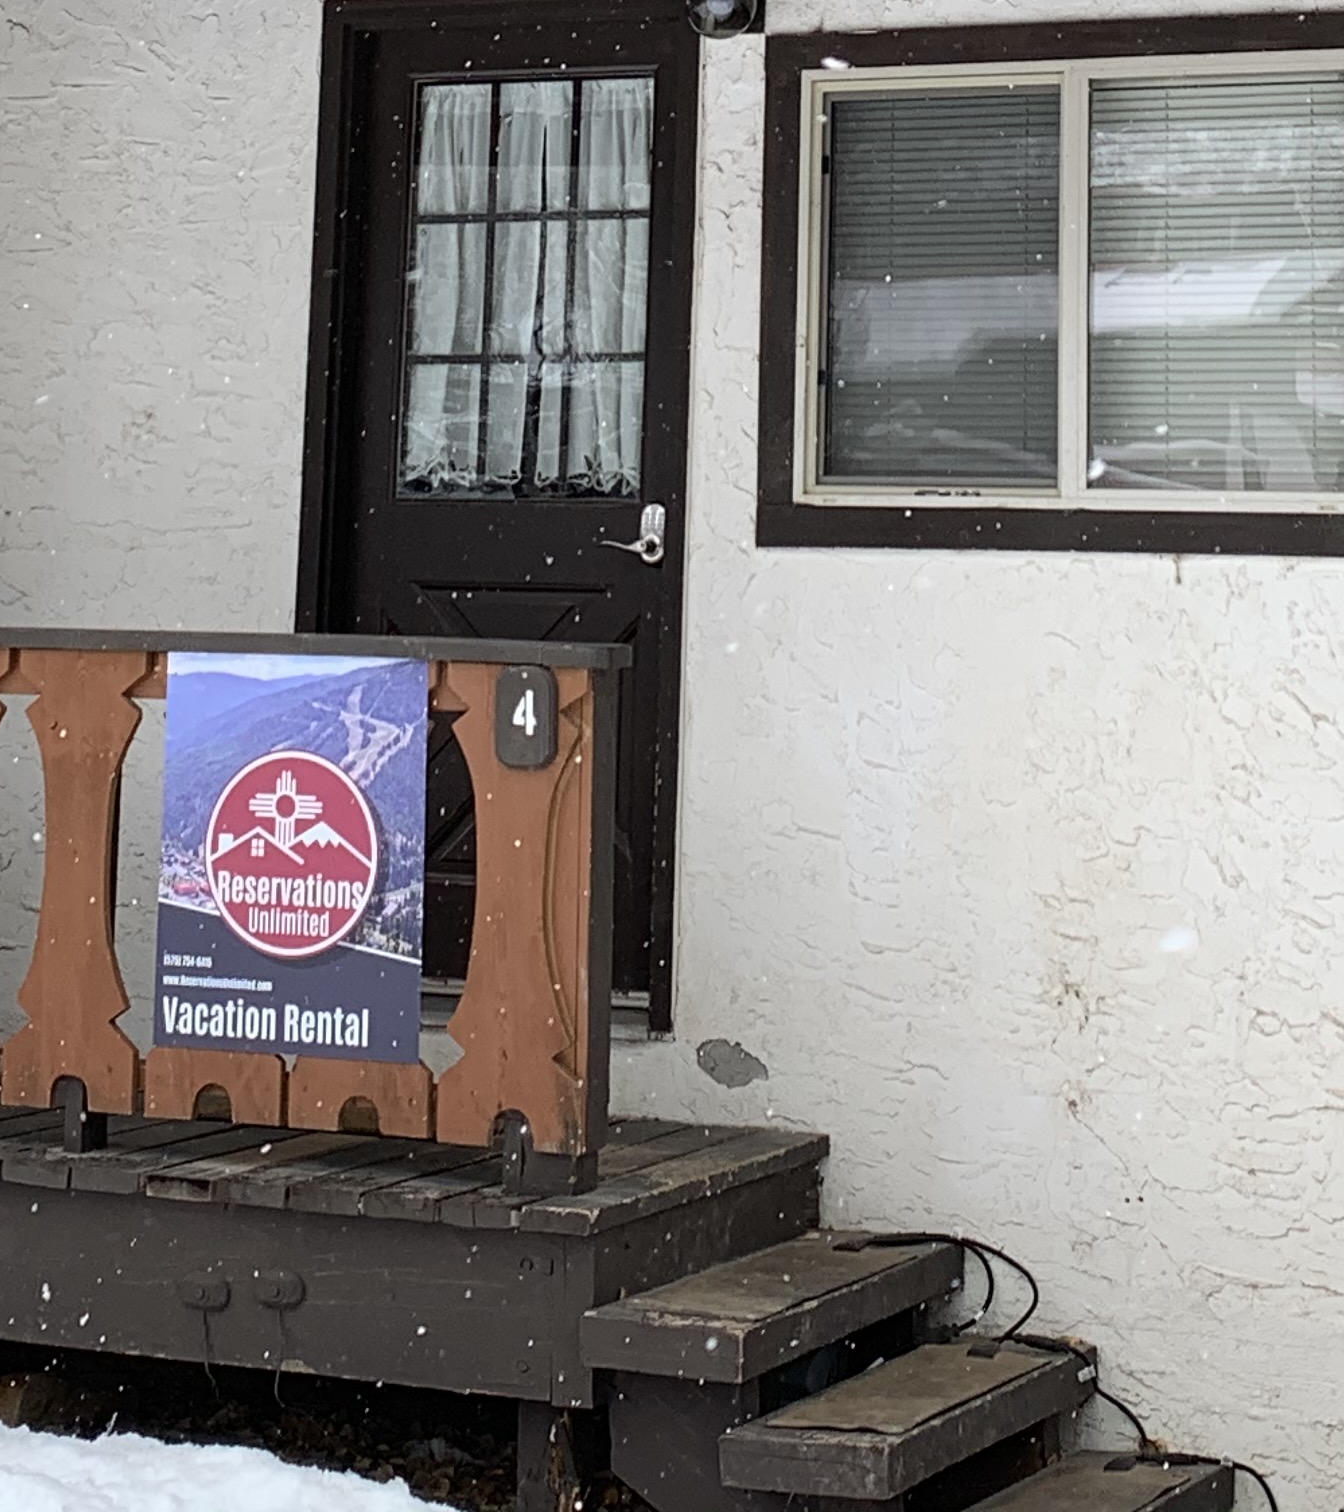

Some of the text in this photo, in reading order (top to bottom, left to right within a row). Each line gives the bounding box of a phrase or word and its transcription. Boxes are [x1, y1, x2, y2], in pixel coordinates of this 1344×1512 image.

[513, 690, 536, 736] 4
[218, 870, 364, 910] Reservations
[248, 907, 330, 938] Unlimited
[163, 996, 369, 1047] Vacation Rental
